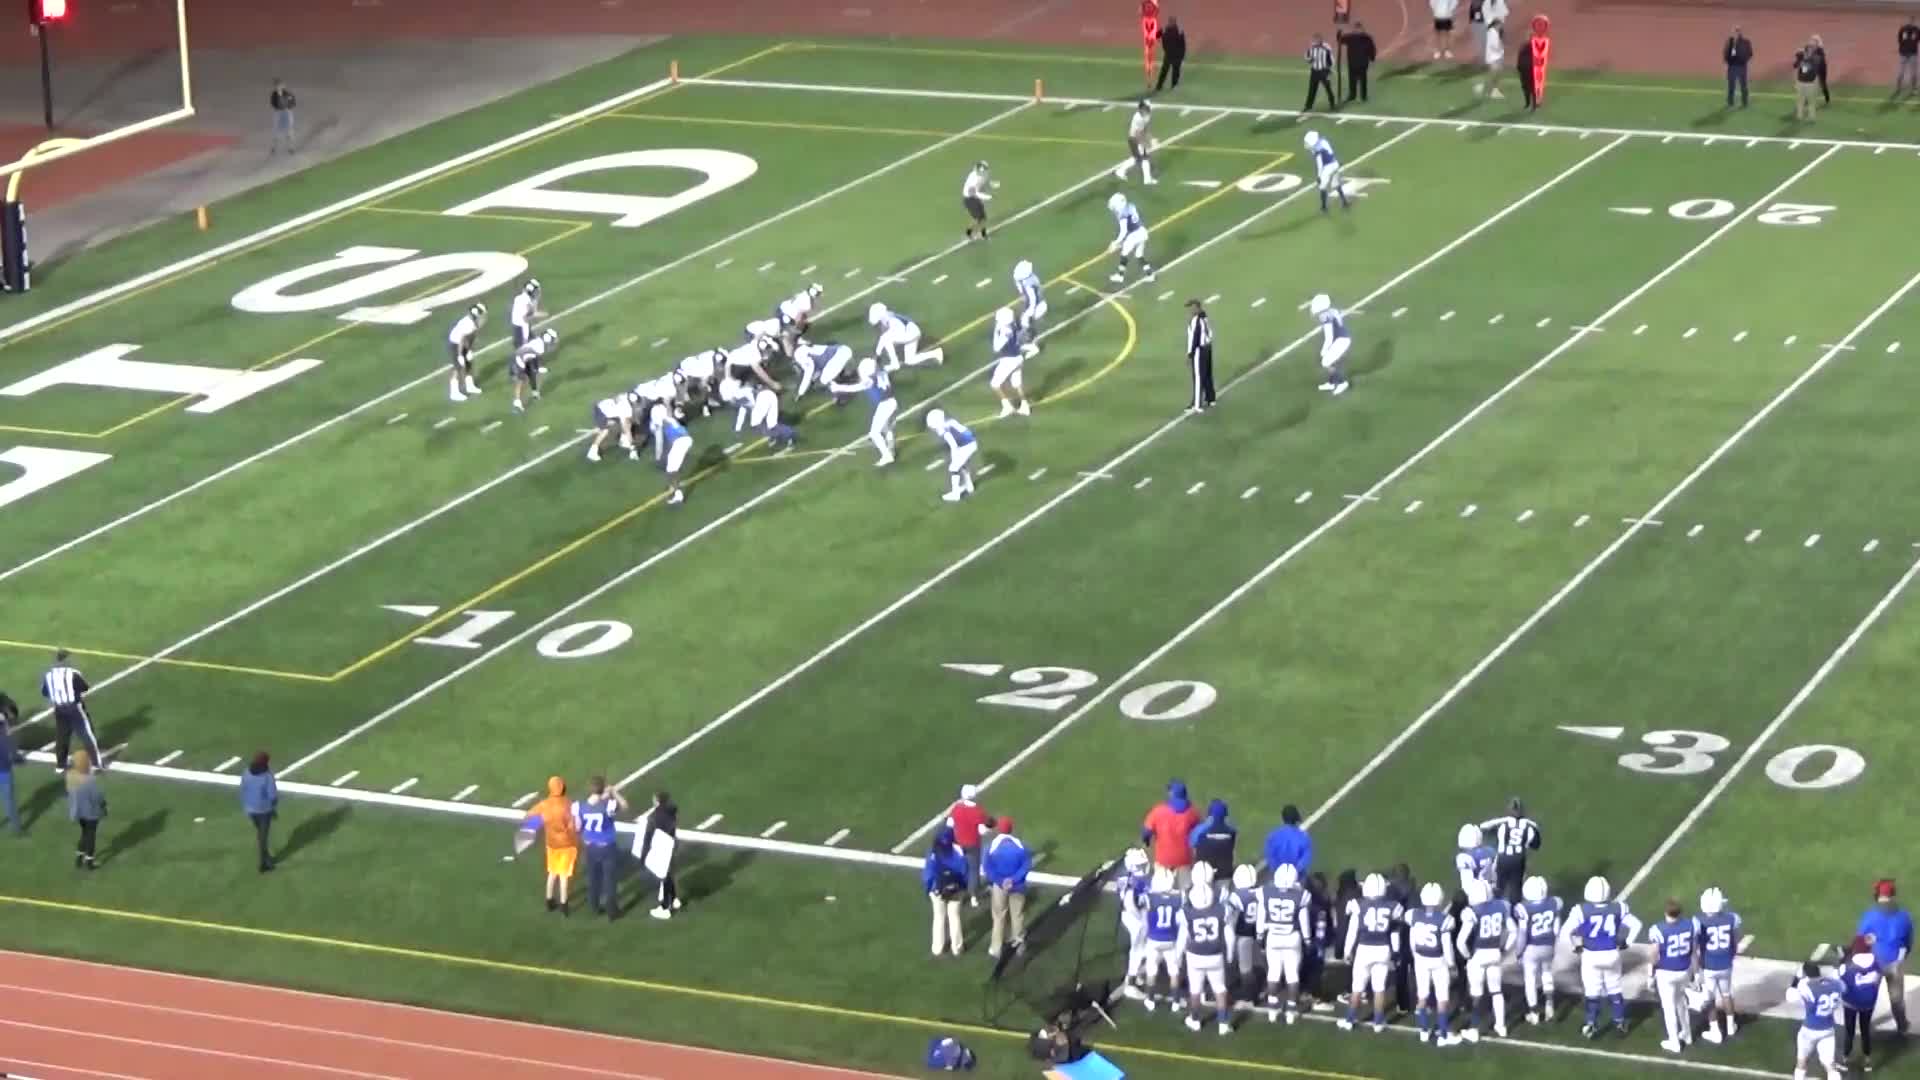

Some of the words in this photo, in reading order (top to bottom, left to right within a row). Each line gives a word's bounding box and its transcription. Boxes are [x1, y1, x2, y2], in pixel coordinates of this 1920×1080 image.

[1668, 197, 1838, 227] 20
[412, 609, 633, 660] 10
[976, 666, 1217, 721] 20
[1617, 729, 1867, 789] 30
[583, 812, 604, 833] 77
[1156, 905, 1173, 928] 11
[1267, 896, 1295, 922] 52
[1363, 906, 1391, 932] 45
[1192, 916, 1220, 943] 53
[1530, 909, 1555, 937] 22
[1589, 913, 1616, 938] 74
[1666, 930, 1692, 958] 25
[1705, 924, 1732, 951] 35
